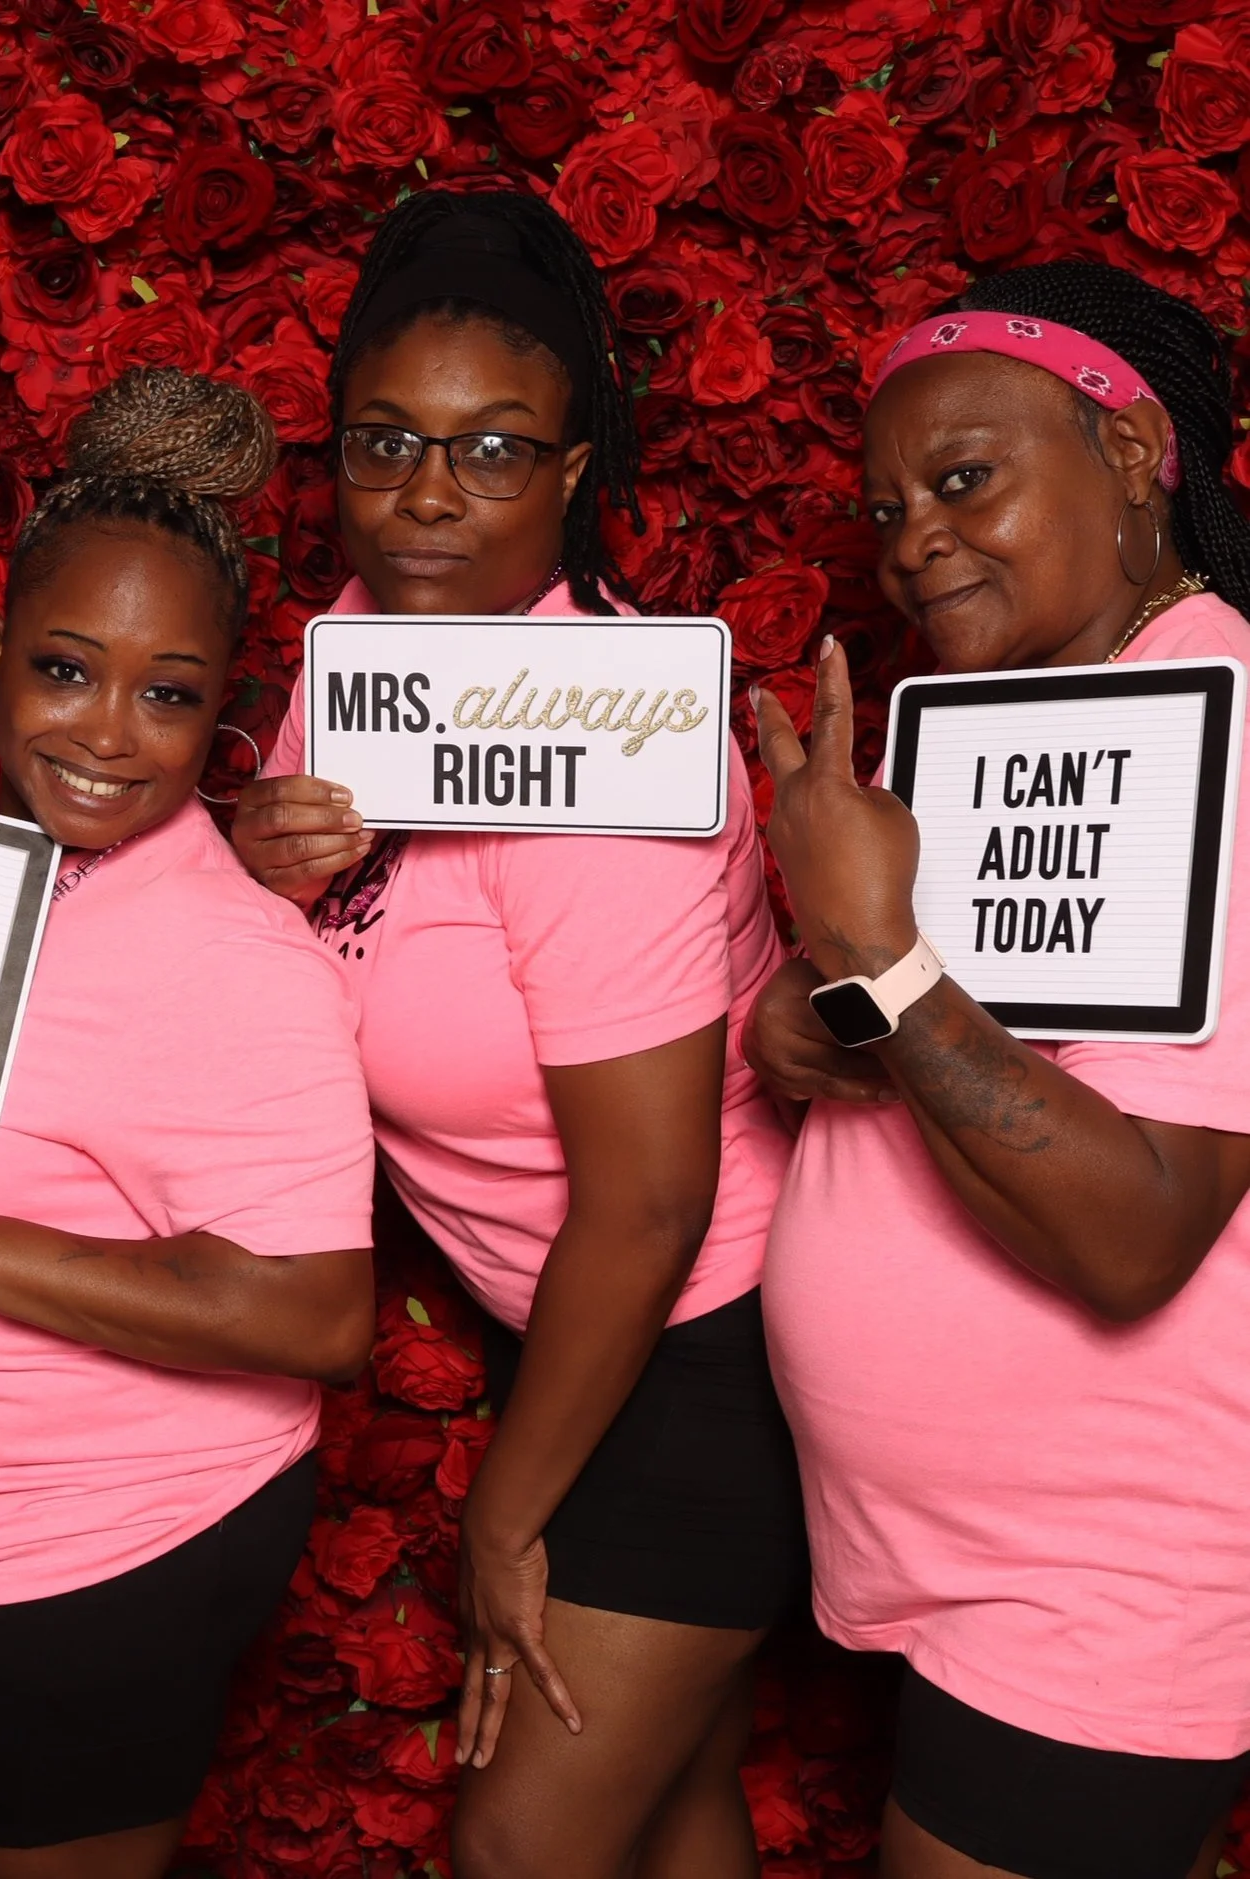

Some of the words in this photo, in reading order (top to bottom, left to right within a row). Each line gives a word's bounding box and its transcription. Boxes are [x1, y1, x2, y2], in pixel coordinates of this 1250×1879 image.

[328, 672, 447, 734] MRS.
[452, 667, 709, 757] always
[433, 743, 587, 808] RIGHT
[973, 756, 986, 809] I
[1003, 749, 1132, 809] CAN'T
[977, 823, 1111, 881] ADULT
[972, 897, 1106, 954] TODAY
